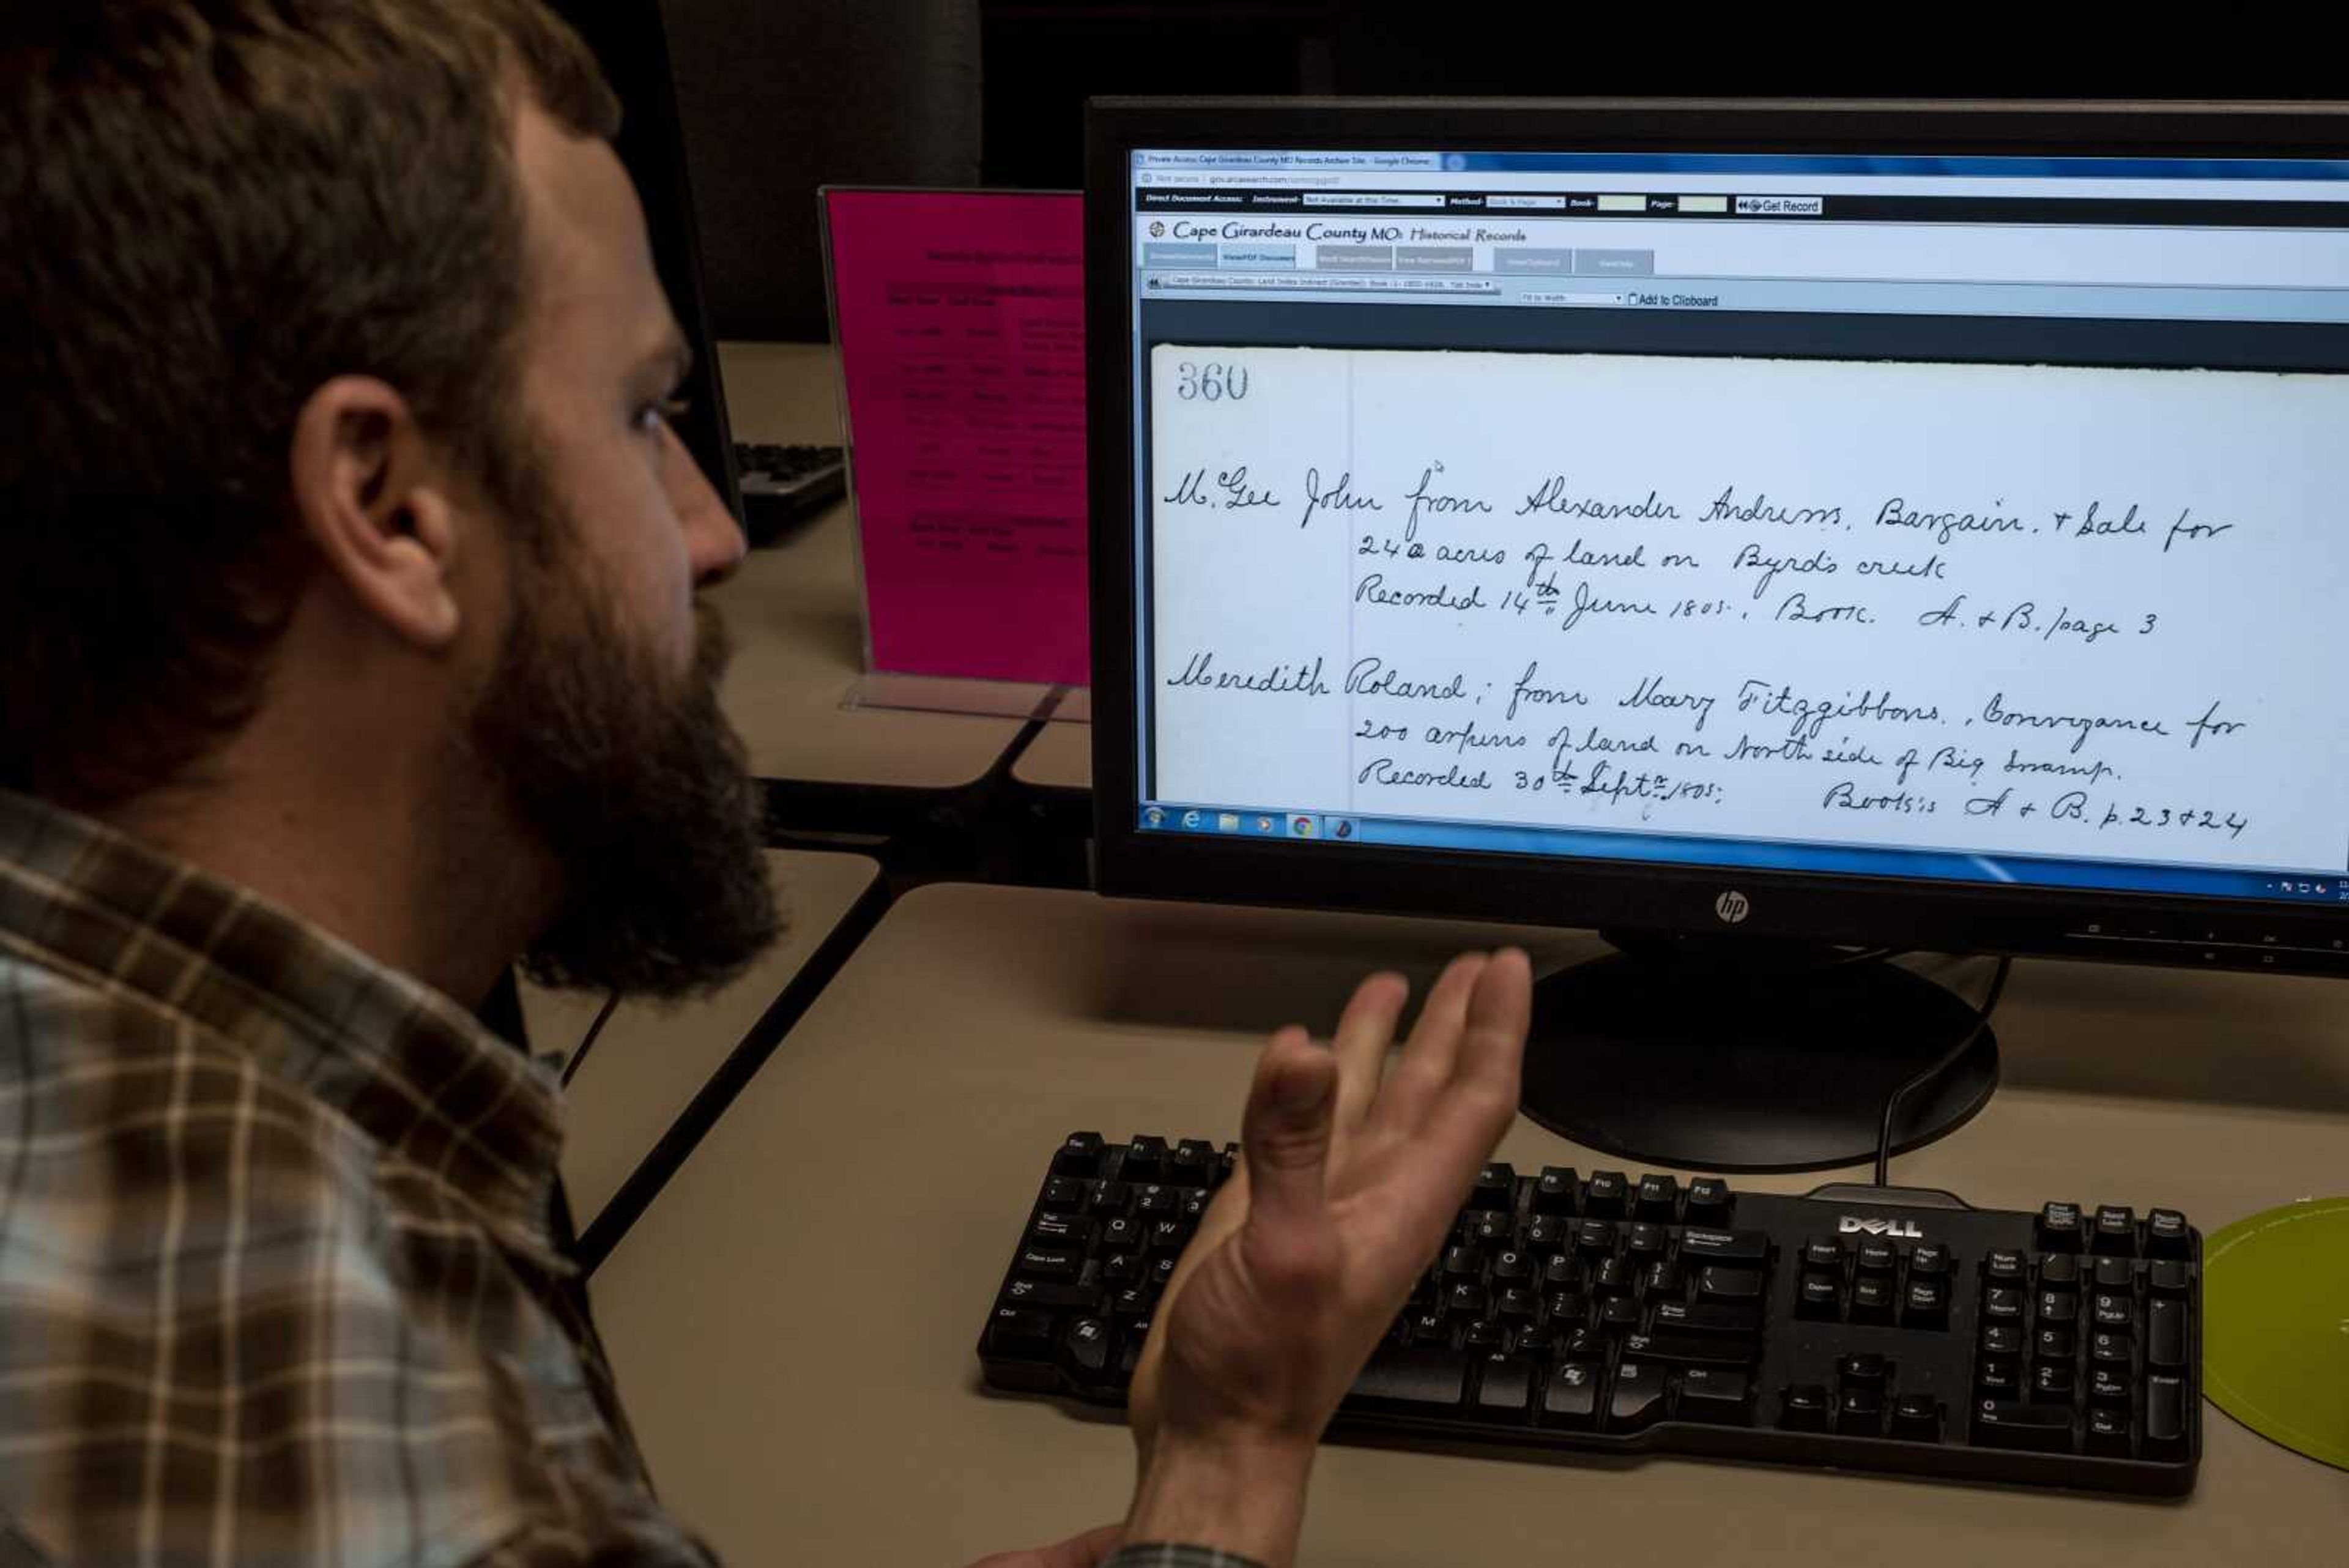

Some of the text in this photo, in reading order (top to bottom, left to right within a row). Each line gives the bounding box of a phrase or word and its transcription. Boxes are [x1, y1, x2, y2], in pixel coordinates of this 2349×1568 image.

[1763, 200, 1781, 211] Get
[1783, 200, 1819, 212] Record
[1173, 221, 1217, 242] Cape
[1222, 221, 1302, 240] Girardeau
[1306, 223, 1367, 243] County
[1409, 227, 1471, 242] Historical
[1475, 228, 1527, 243] Records
[1639, 294, 1719, 307] Add to Clipboard
[1178, 361, 1249, 401] 360
[1301, 467, 1383, 529] John
[1405, 467, 1493, 541] from
[1515, 475, 1681, 520] Alexander
[2162, 508, 2235, 553] for
[1436, 541, 1507, 565] acres
[1524, 542, 1553, 588] of
[1563, 538, 1646, 568] land
[1661, 554, 1700, 568] on
[1857, 554, 1948, 579] creek
[1355, 573, 1486, 611] Recorded
[1562, 581, 1657, 631] June
[2139, 612, 2158, 634] 3
[1167, 652, 1330, 696] Meredith
[1506, 661, 1589, 721] from
[1619, 675, 1715, 732] Mary
[2186, 700, 2247, 749] for
[1355, 719, 1408, 741] 200
[1547, 726, 1573, 770] of
[1575, 726, 1660, 753] land
[1675, 741, 1710, 758] on
[1822, 735, 1883, 767] side
[1896, 748, 1920, 785] of
[1928, 746, 1984, 777] Big
[1358, 759, 1492, 789] Recorded
[1964, 787, 2014, 816] A
[1717, 890, 1748, 924] hp
[1159, 1222, 1176, 1235] W
[1838, 1215, 1923, 1238] DELL
[1110, 1254, 1124, 1266] A
[1502, 1252, 1517, 1265] O
[1552, 1255, 1567, 1266] P
[1123, 1289, 1140, 1301] Z
[1455, 1284, 1469, 1296] K
[1990, 1288, 2004, 1299] 7
[2099, 1296, 2112, 1309] 9
[1420, 1315, 1436, 1328] M
[1987, 1327, 2000, 1339] 4
[2043, 1331, 2054, 1342] 5
[2098, 1334, 2110, 1346] 6
[2040, 1367, 2053, 1378] 2
[1983, 1399, 1995, 1411] 0
